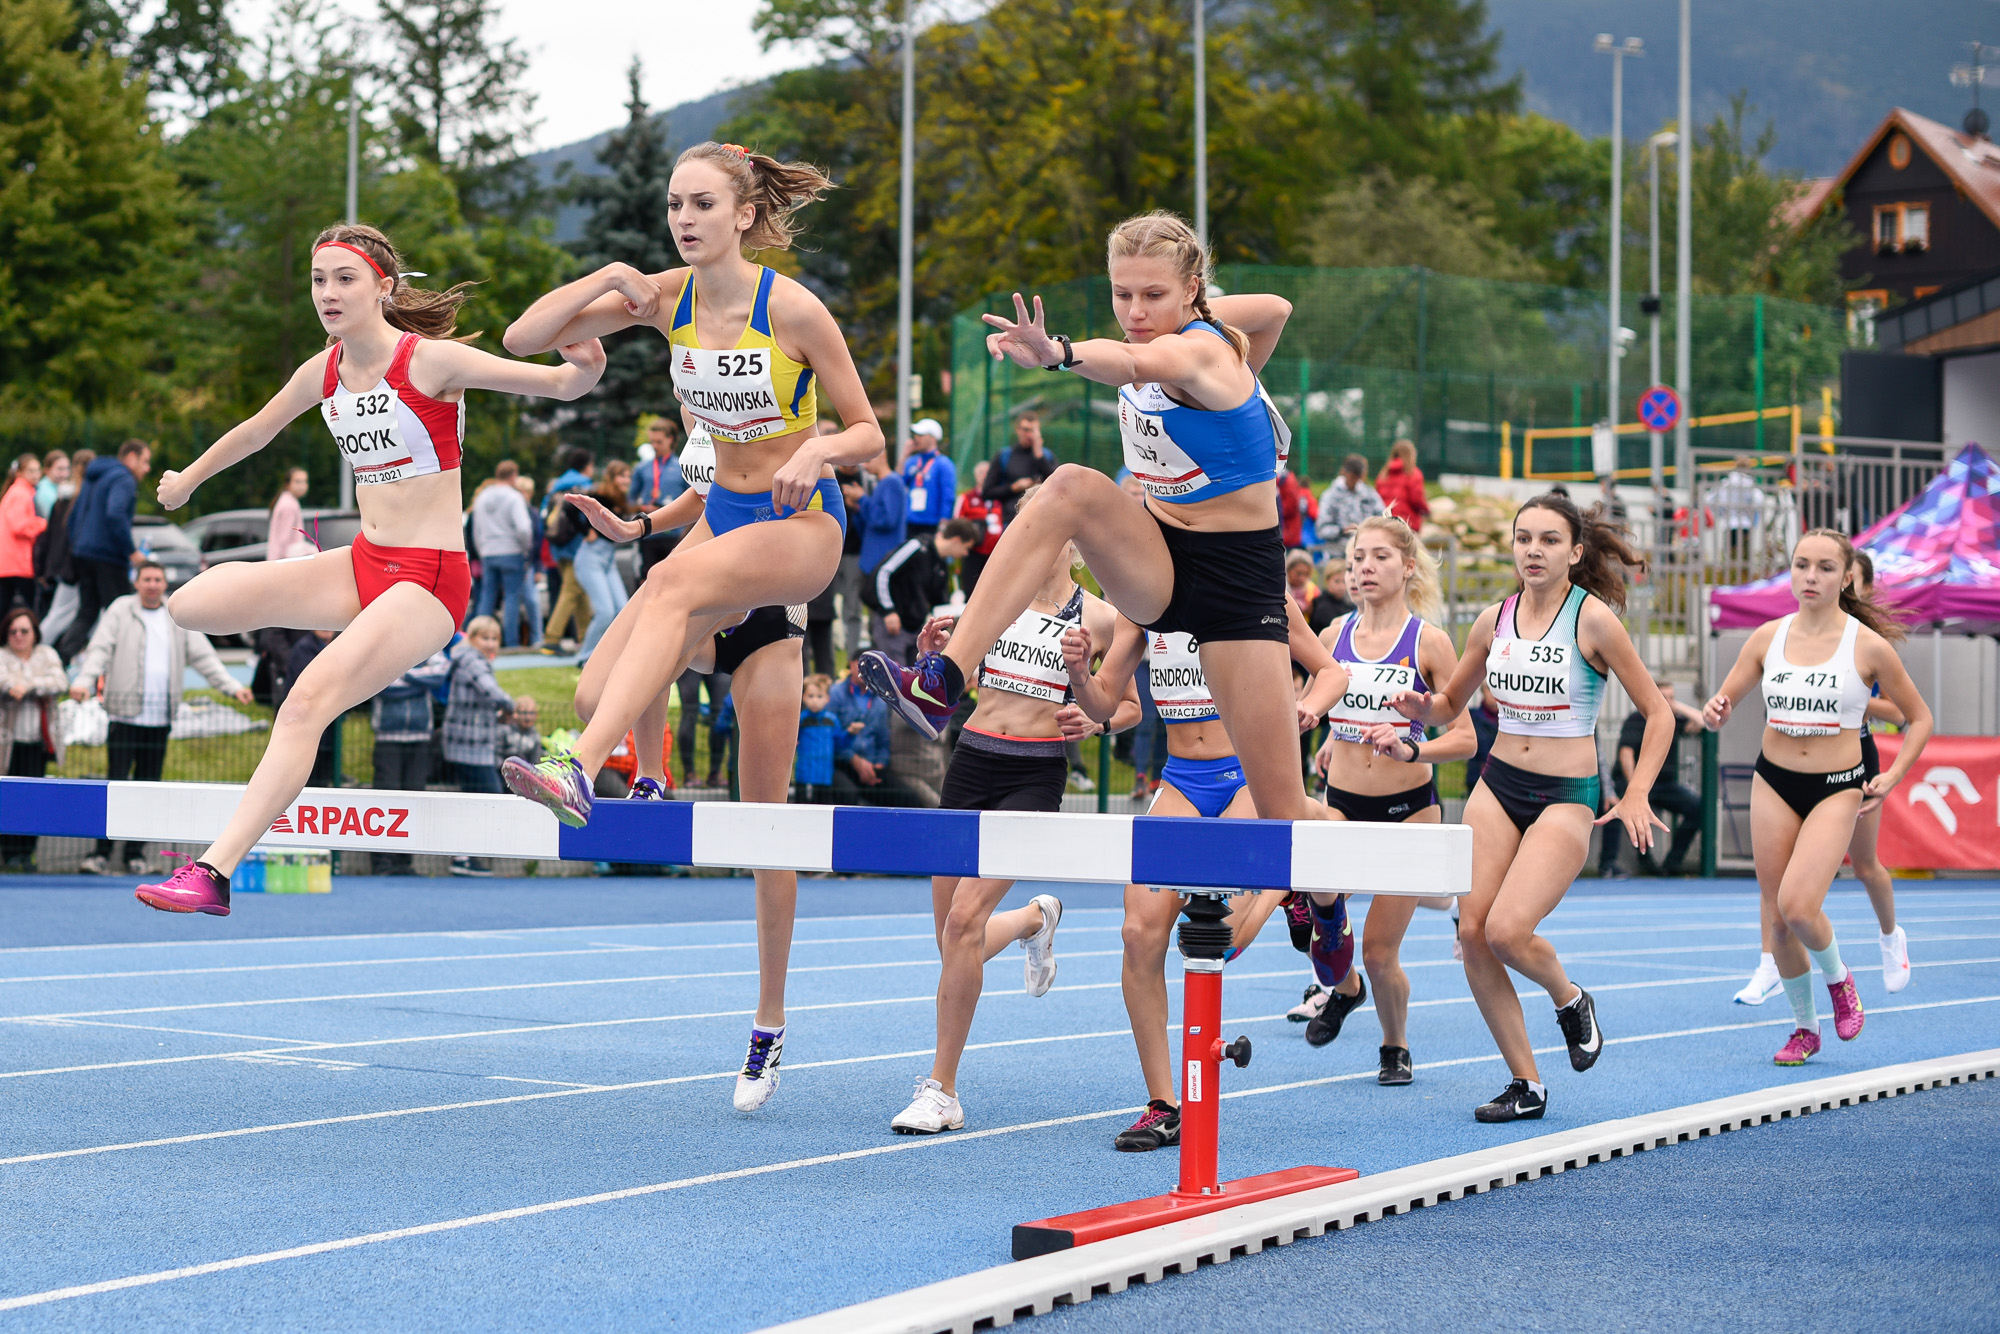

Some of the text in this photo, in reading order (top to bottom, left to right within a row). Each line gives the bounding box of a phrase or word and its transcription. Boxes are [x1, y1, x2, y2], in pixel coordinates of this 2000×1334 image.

[717, 353, 763, 376] 525
[356, 393, 390, 417] 532
[742, 425, 769, 441] 2021
[379, 469, 402, 481] 2021
[1170, 483, 1194, 495] 2021
[1038, 617, 1076, 638] 77
[1529, 646, 1564, 664] 535
[1151, 667, 1207, 688] CENDROW
[1374, 667, 1409, 685] 773
[1489, 671, 1565, 695] CHUDZIK
[1805, 673, 1838, 689] 471
[990, 676, 1029, 694] KARPACZ
[1030, 686, 1052, 699] 2021
[1160, 707, 1197, 717] KARPACZ
[1767, 695, 1838, 713] GRUBIAK
[1534, 712, 1556, 721] 2021
[1826, 770, 1853, 784] NIKE
